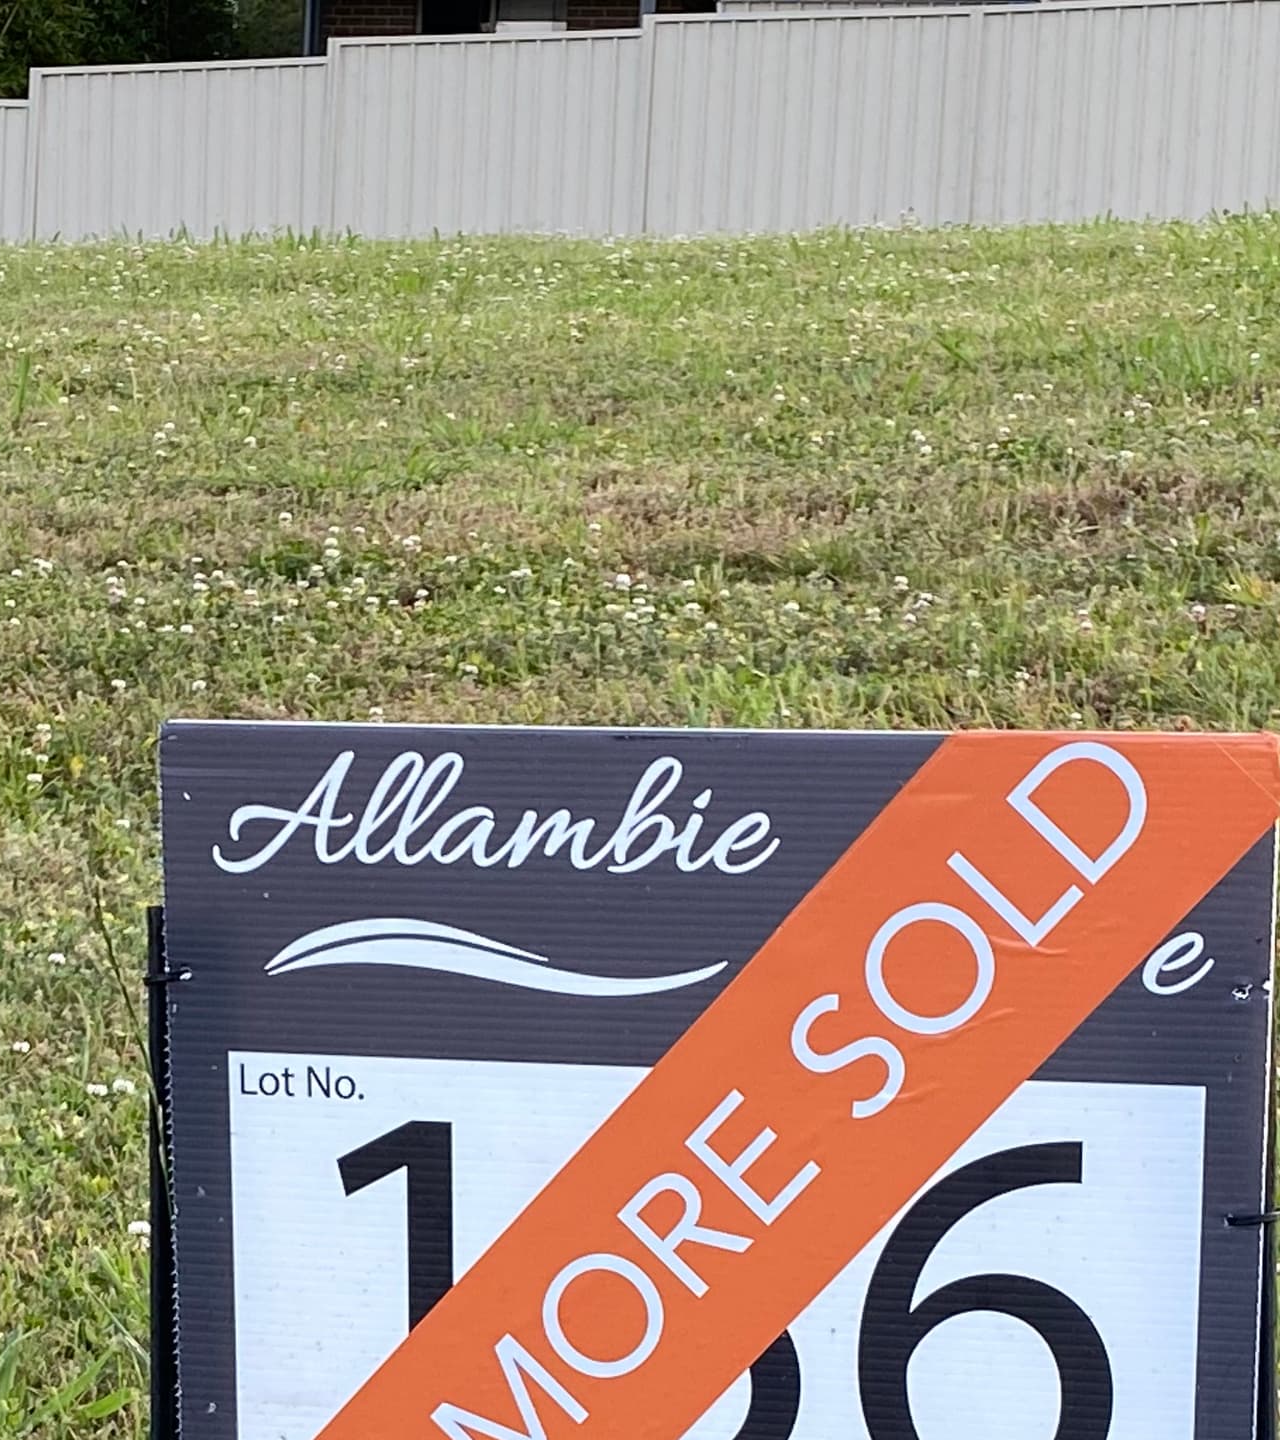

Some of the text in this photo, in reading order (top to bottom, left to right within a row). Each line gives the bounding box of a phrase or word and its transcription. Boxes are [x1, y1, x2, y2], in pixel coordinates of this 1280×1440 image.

[212, 750, 781, 874] Allambie
[790, 741, 1148, 1119] SOLD
[239, 1063, 366, 1101] Lot No.
